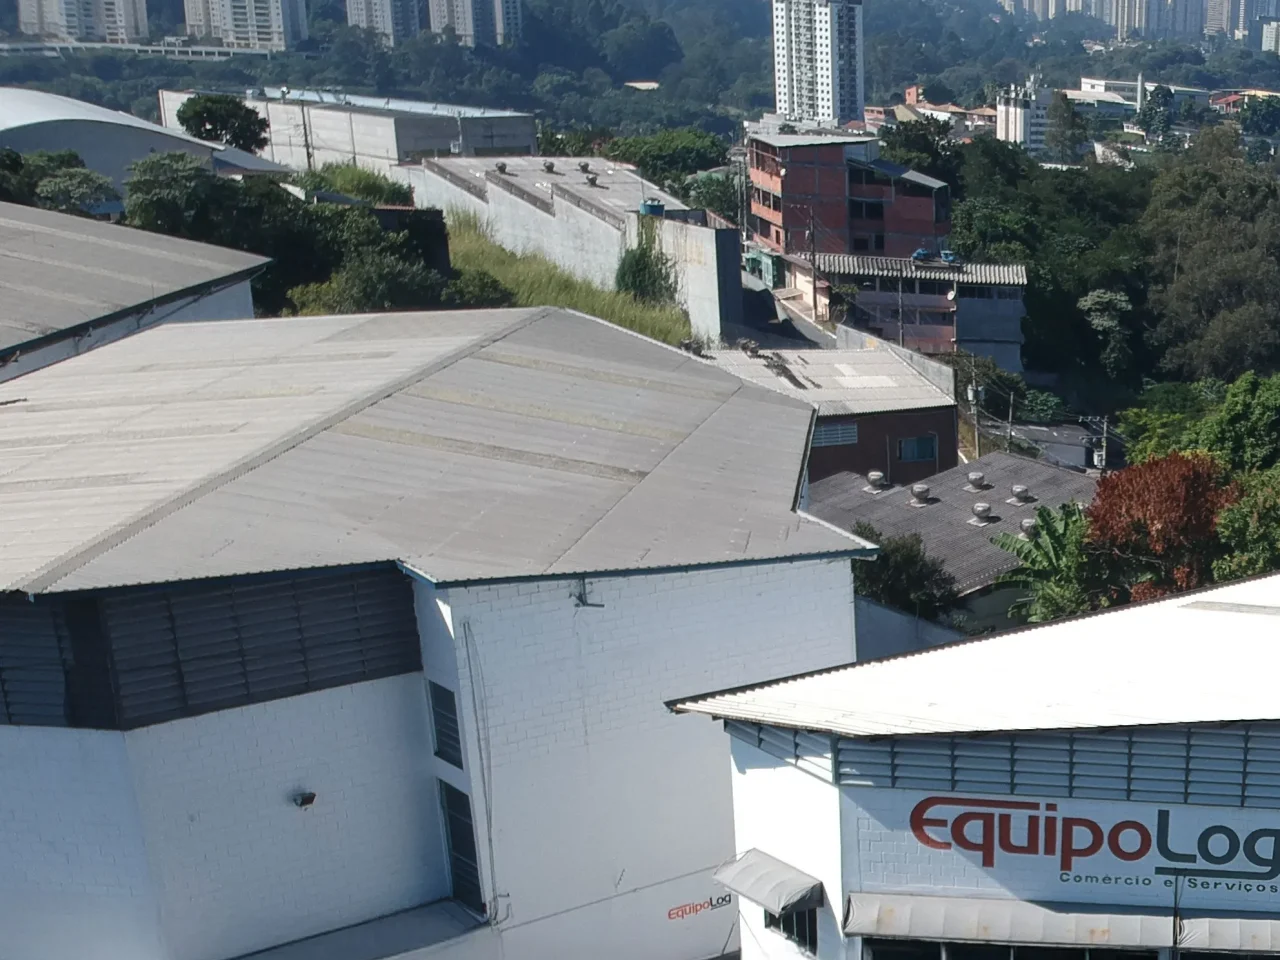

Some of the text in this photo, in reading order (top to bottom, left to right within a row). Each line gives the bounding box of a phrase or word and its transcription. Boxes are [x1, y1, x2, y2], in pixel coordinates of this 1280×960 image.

[1163, 880, 1173, 888] e
[1187, 877, 1279, 893] Serviços
[667, 893, 732, 921] EquipoLog
